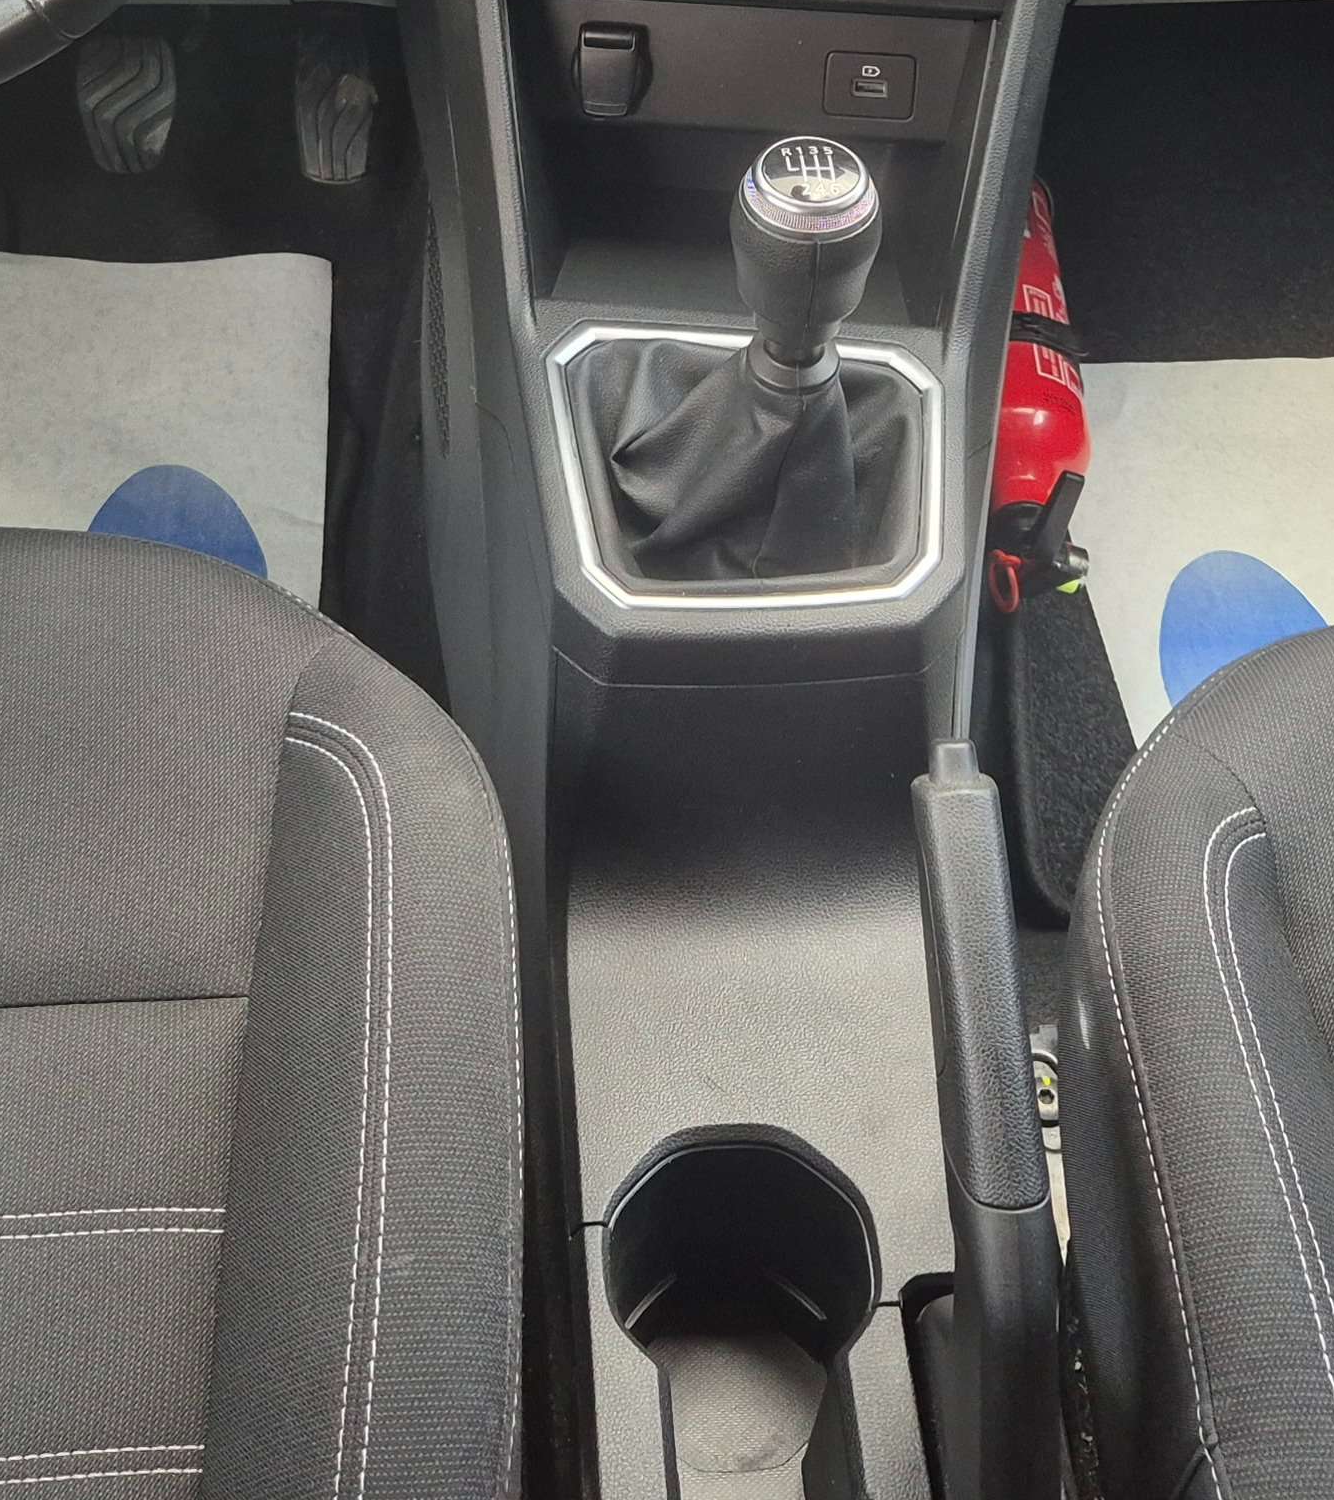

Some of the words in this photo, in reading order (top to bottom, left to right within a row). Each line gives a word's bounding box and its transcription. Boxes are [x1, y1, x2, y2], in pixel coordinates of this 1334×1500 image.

[781, 147, 792, 156] R
[809, 147, 818, 156] 3
[823, 147, 834, 156] 5
